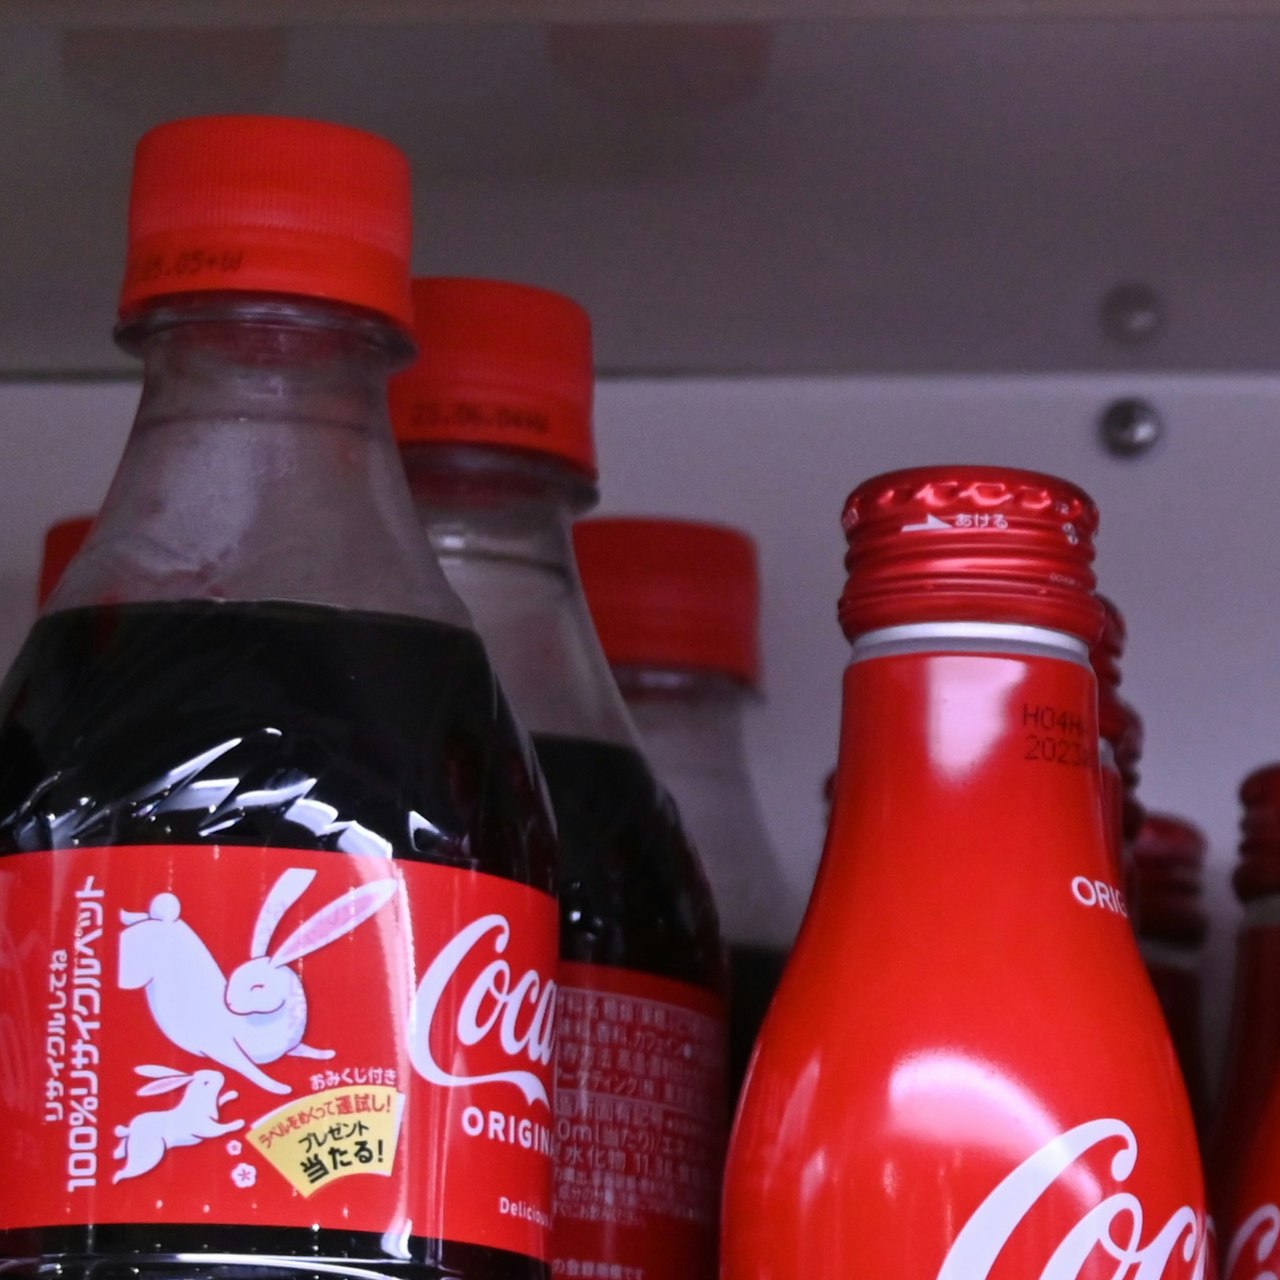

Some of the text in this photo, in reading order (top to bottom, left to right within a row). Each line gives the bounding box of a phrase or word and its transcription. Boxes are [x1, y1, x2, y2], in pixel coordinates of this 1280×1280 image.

[45, 949, 67, 1122] リサイクルしてね
[67, 876, 105, 1192] 100%リサイクルペット
[310, 1068, 398, 1091] おみくじ付き
[298, 1120, 369, 1154] プレゼント
[461, 1106, 556, 1157] ORIGIN
[300, 1139, 384, 1185] 当たる!
